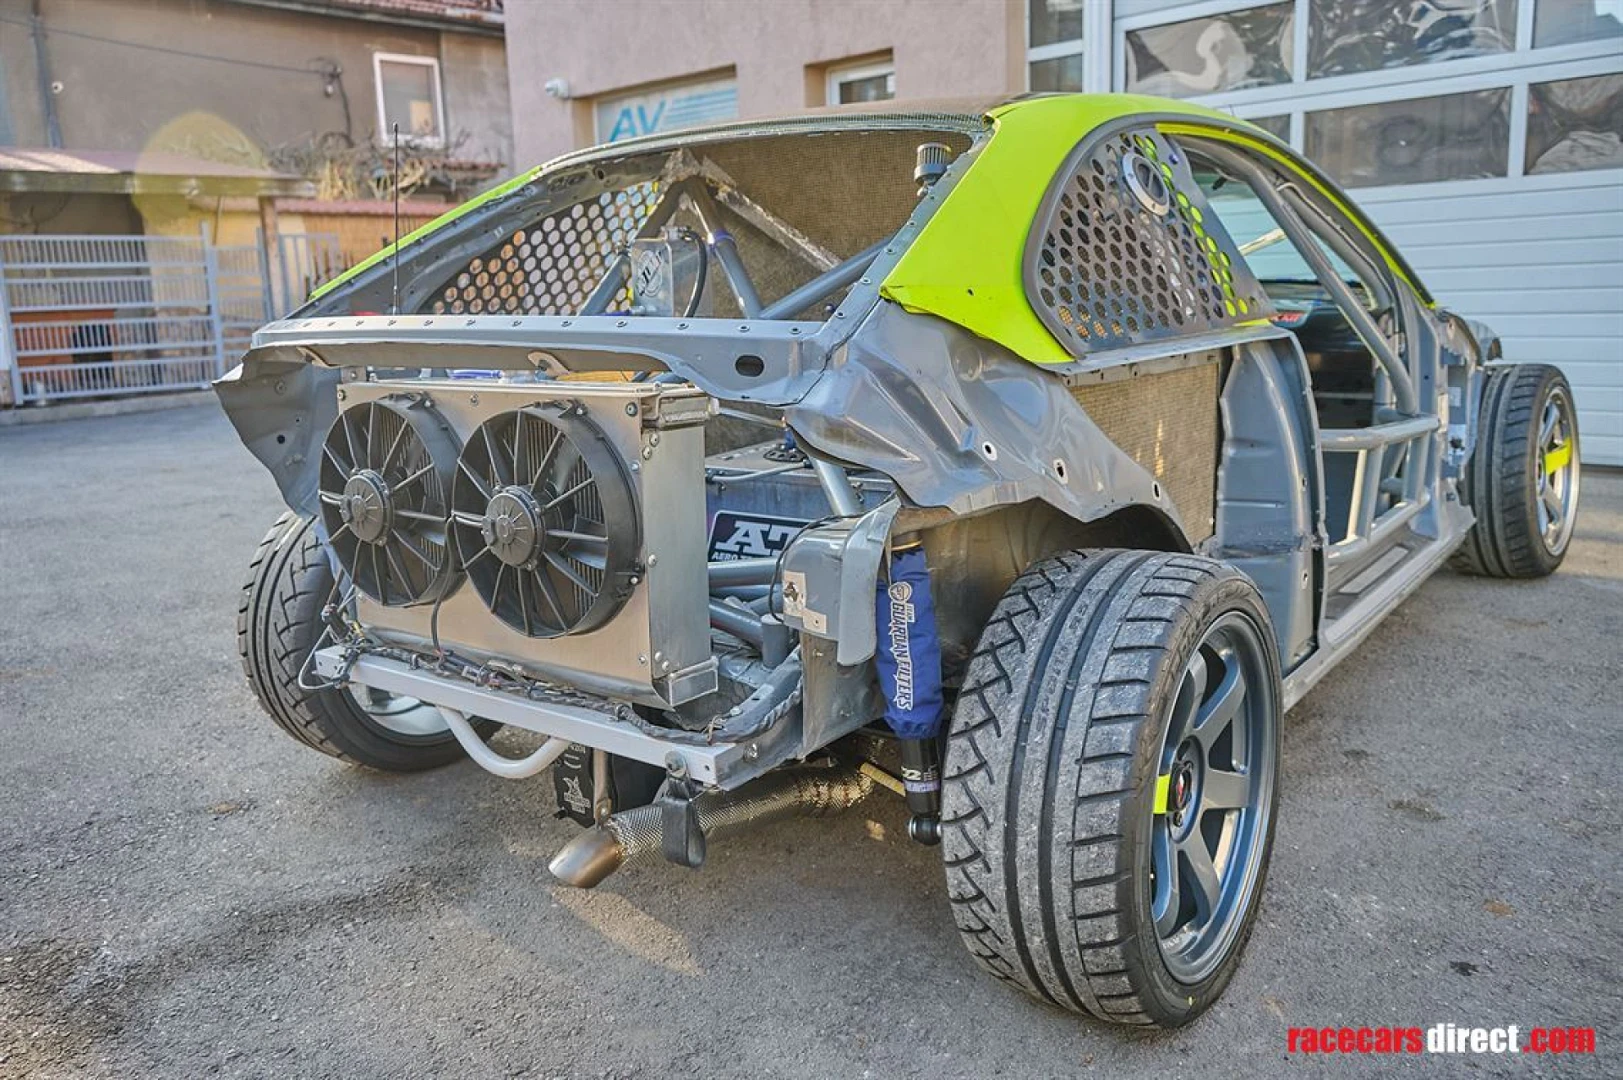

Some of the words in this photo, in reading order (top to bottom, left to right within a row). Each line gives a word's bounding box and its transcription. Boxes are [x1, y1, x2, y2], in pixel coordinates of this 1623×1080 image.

[609, 98, 665, 142] AV
[892, 602, 909, 658] GUARDIAN
[897, 661, 913, 710] FILTERS
